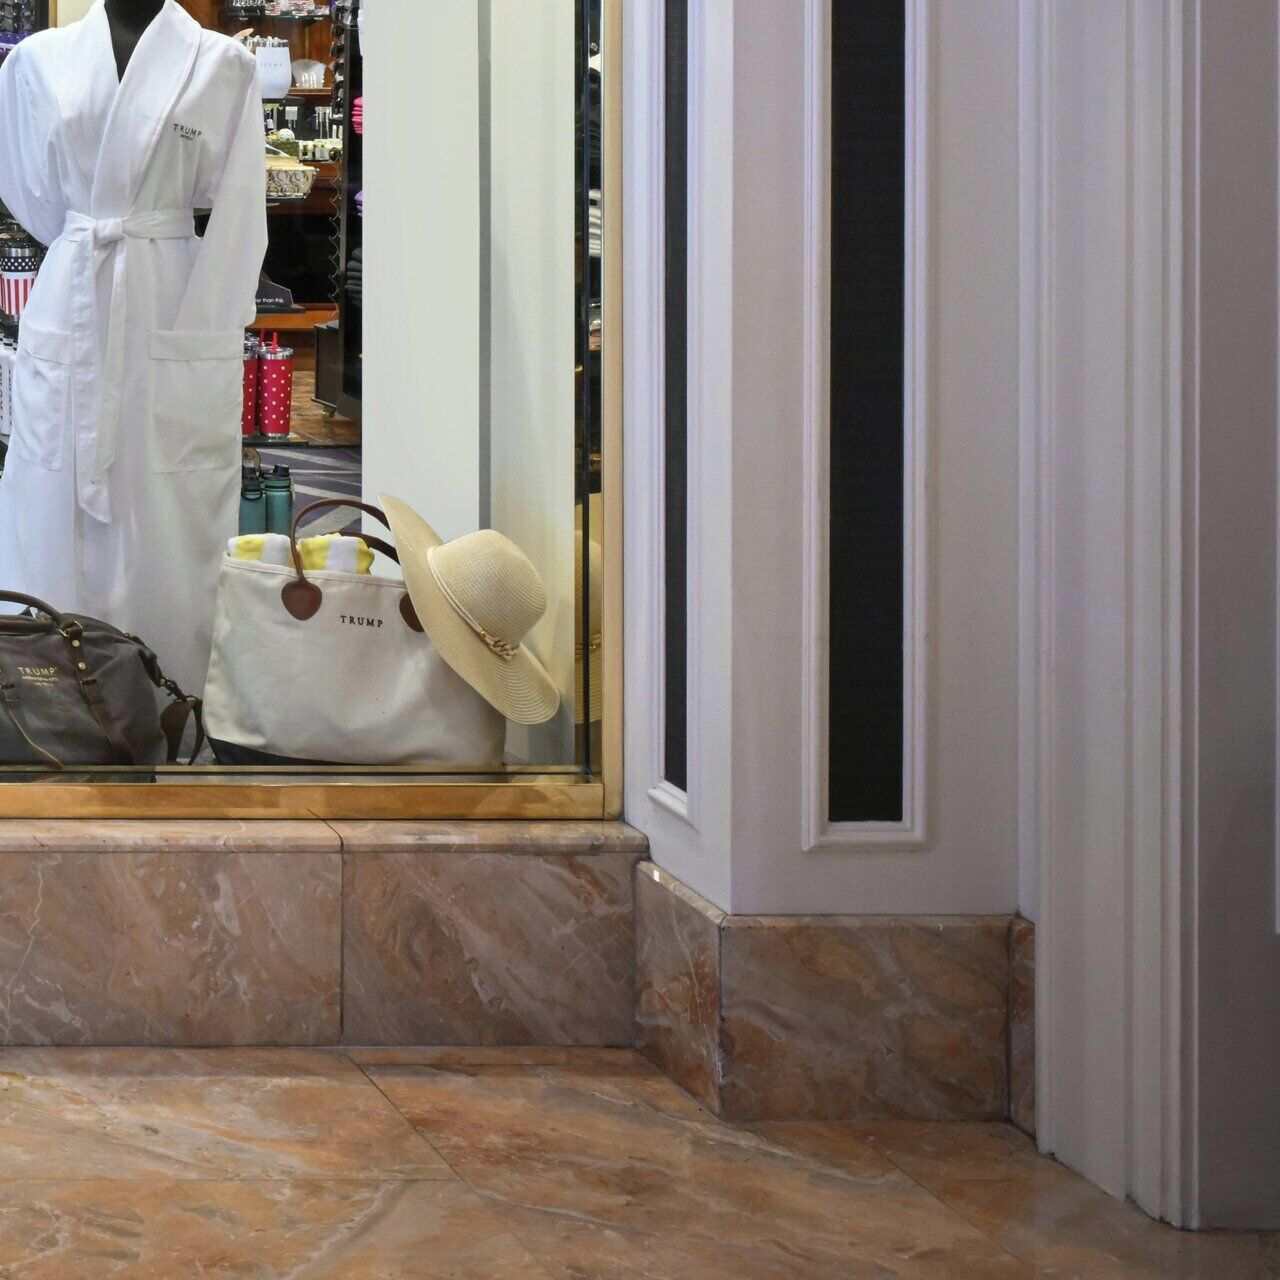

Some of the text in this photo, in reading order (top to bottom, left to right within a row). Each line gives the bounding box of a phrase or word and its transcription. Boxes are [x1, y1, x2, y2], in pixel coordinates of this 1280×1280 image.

[173, 123, 202, 138] TRUMP
[340, 614, 384, 628] TRUMP
[17, 666, 55, 676] TRUMP
